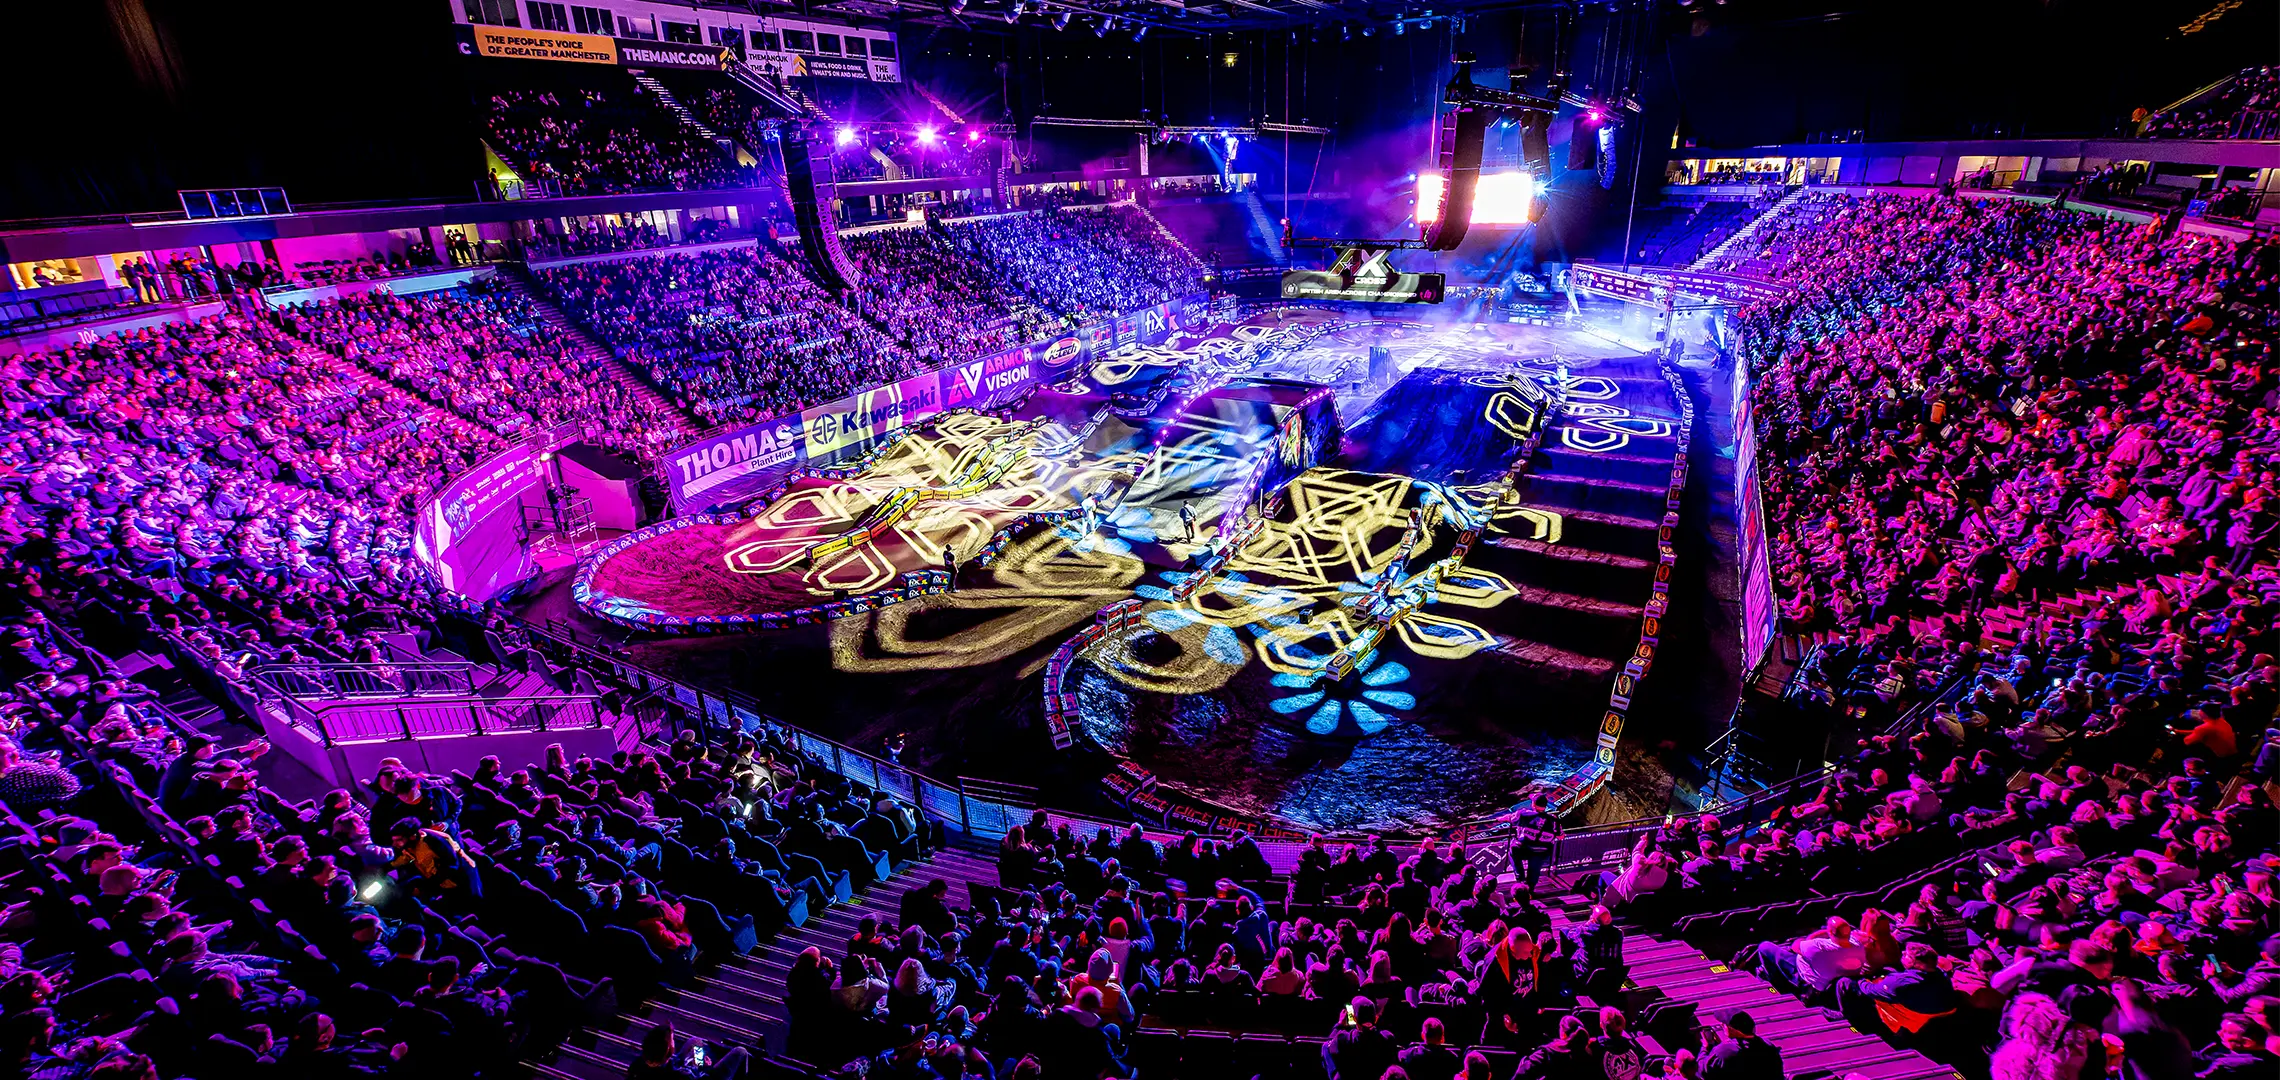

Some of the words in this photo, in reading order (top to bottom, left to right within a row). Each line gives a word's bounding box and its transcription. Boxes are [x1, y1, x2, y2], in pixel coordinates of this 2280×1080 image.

[485, 35, 505, 44] THE
[508, 37, 554, 48] PEOPLE'S
[555, 40, 583, 49] VOICE
[488, 46, 501, 54] OF
[504, 47, 549, 57] GREATER
[551, 50, 610, 61] MANCHESTER
[622, 48, 717, 66] THEMANC.COM
[875, 64, 888, 73] THE
[876, 74, 896, 82] MANC
[1355, 277, 1388, 285] CROSS
[78, 329, 99, 345] 106
[1091, 327, 1111, 343] dirt
[985, 347, 1033, 375] ARMOR
[985, 365, 1030, 392] VISION
[842, 386, 936, 434] Kawasaki
[676, 424, 794, 483] THOMAS
[751, 455, 774, 469] Plant
[775, 449, 793, 461] Hire
[1122, 760, 1150, 778] dirt
[1101, 777, 1128, 796] STORE
[1106, 772, 1134, 791] dirt
[1131, 797, 1164, 814] STORE
[1136, 791, 1169, 808] dirt
[1553, 792, 1575, 807] STORE
[1172, 812, 1209, 827] STORE
[1174, 805, 1213, 823] dirt
[1218, 817, 1258, 832] dirt
